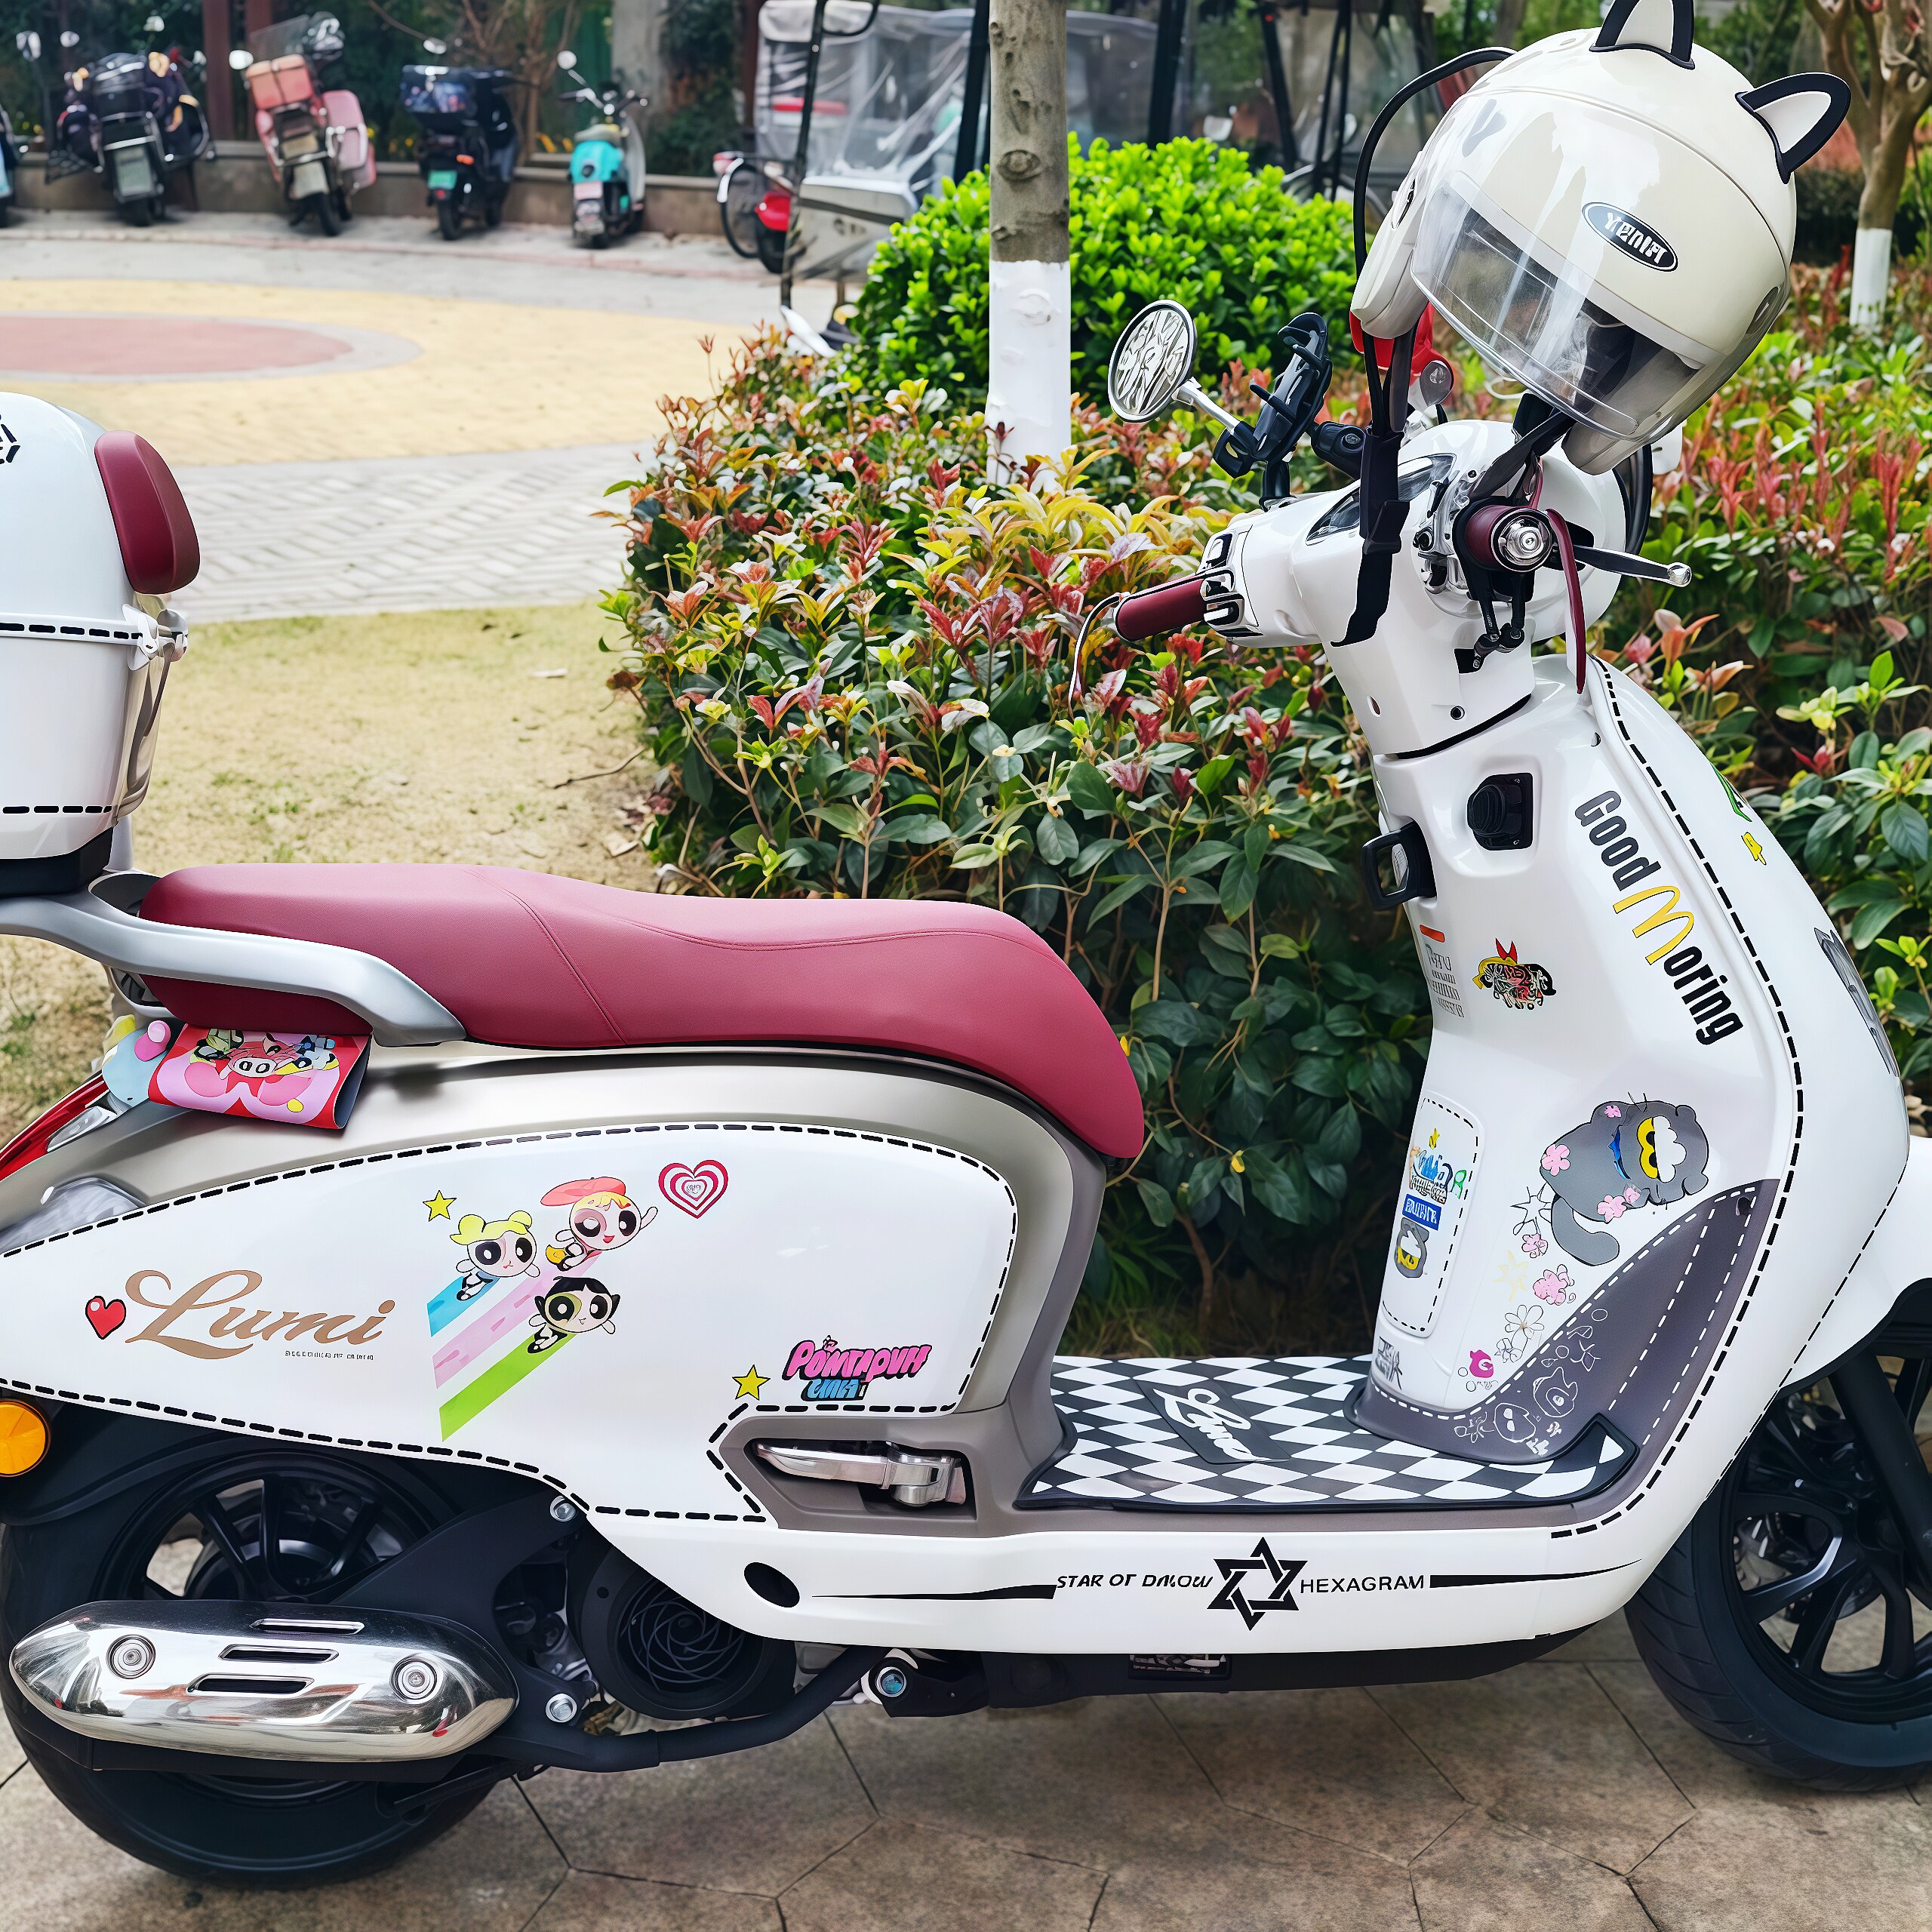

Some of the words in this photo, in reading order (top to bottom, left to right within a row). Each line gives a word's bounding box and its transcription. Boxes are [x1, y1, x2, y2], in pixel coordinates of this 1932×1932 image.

[1574, 790, 1662, 891] Good
[125, 1269, 395, 1360] Lumi
[1057, 1574, 1104, 1589] STAR
[1300, 1574, 1424, 1594] HEXAGRAM
